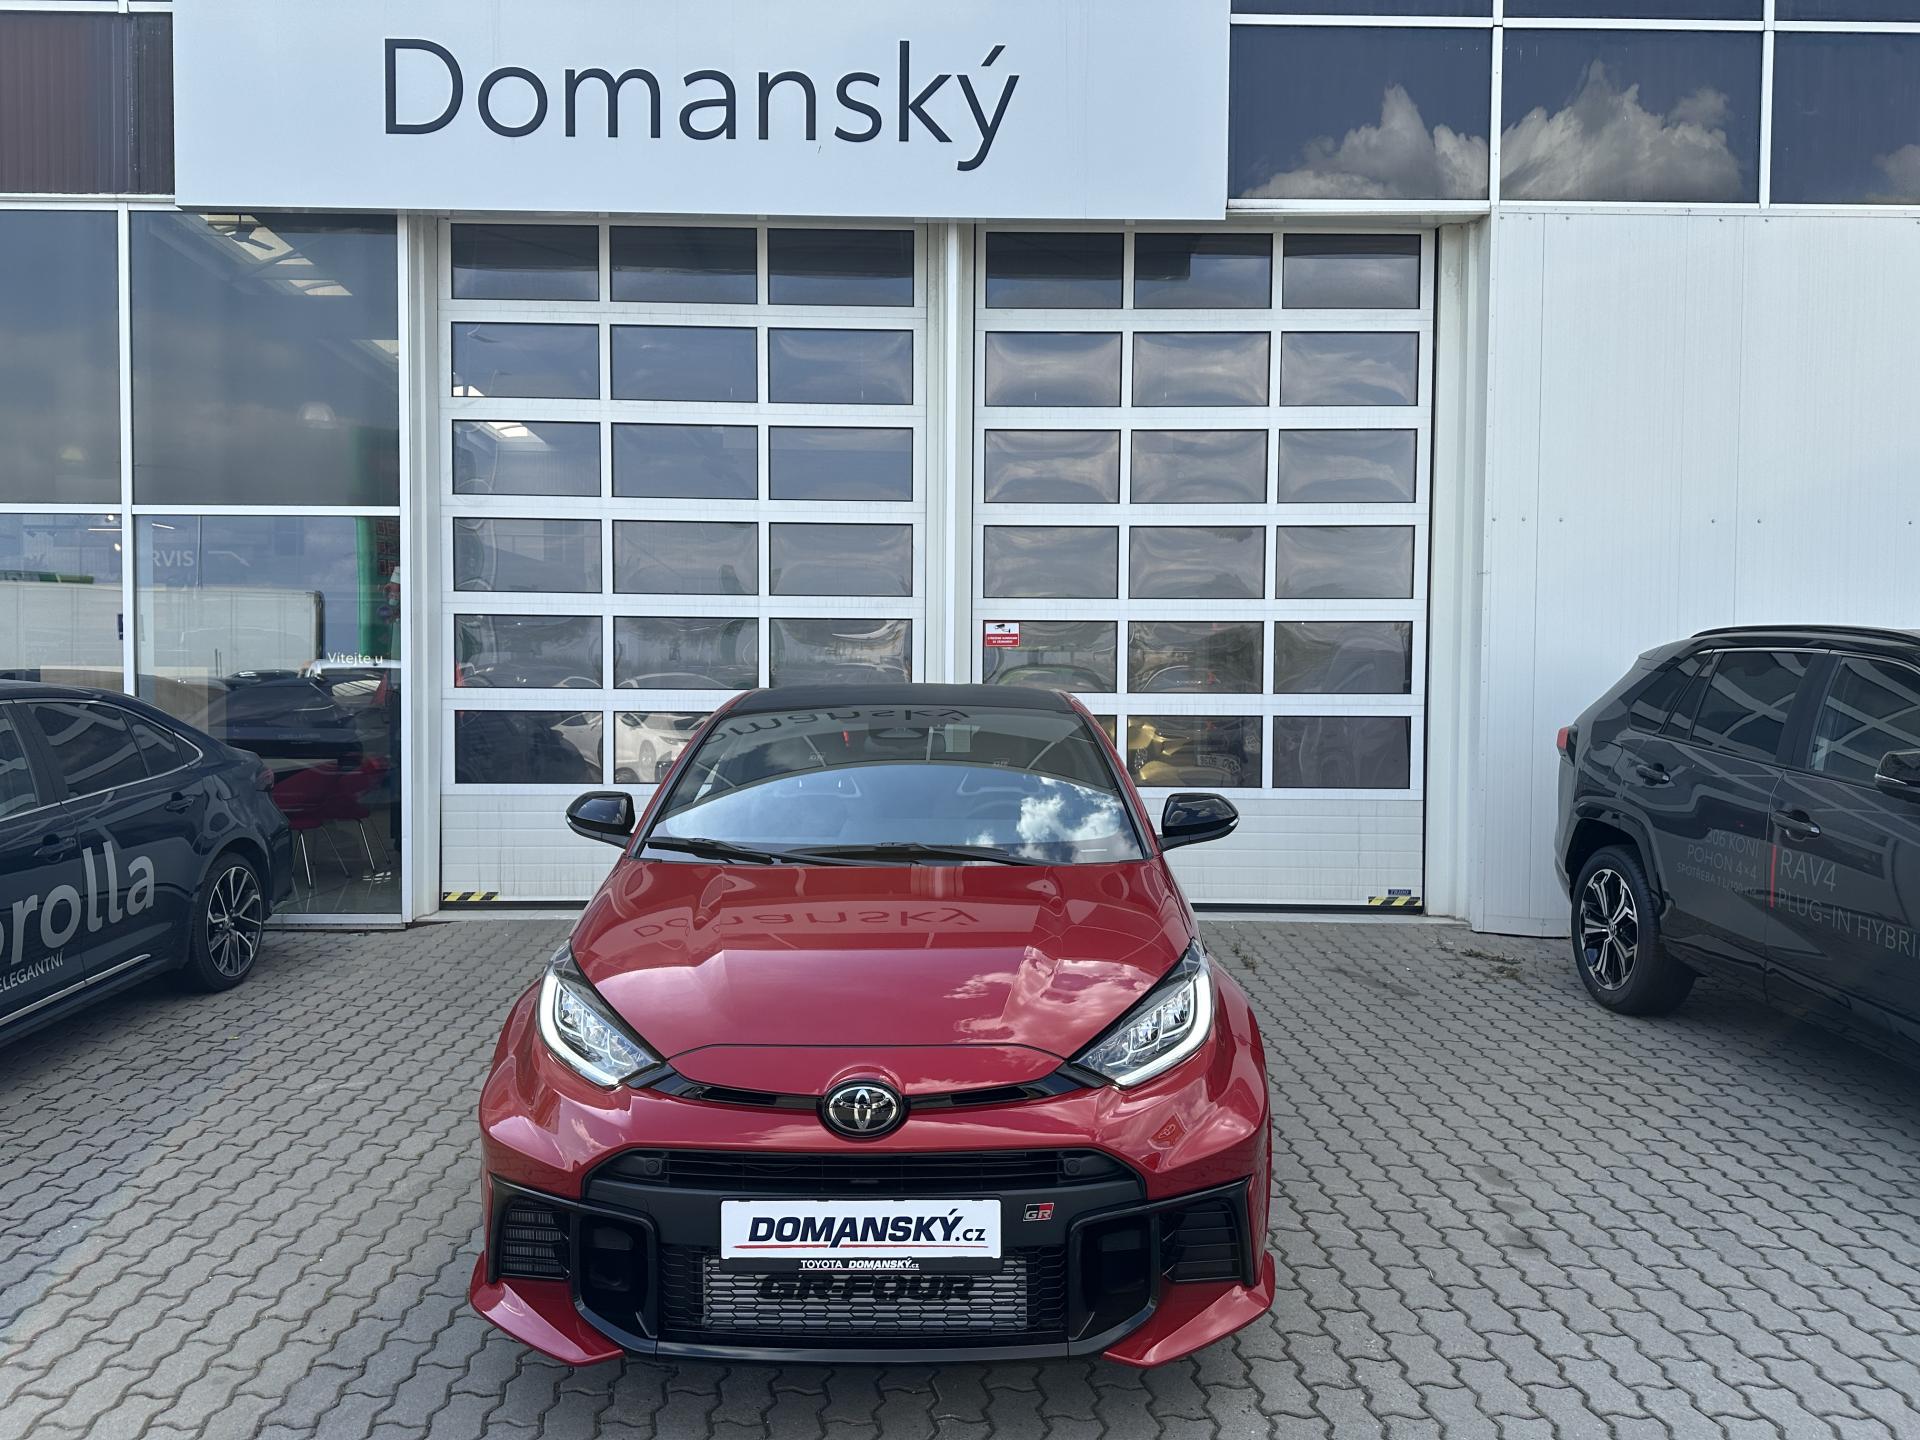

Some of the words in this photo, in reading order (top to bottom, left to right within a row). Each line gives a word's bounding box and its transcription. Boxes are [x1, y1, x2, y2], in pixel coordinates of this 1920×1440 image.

[385, 38, 1020, 172] Domanský
[1687, 844, 1733, 872] POHON
[1780, 849, 1837, 892] RAV4
[0, 840, 155, 966] rolla
[1778, 887, 1851, 934] PLUG-IN
[1857, 915, 1920, 960] HYBRI
[748, 1208, 986, 1248] DOMANSKÝ.cz
[800, 1259, 843, 1269] TOYOTA
